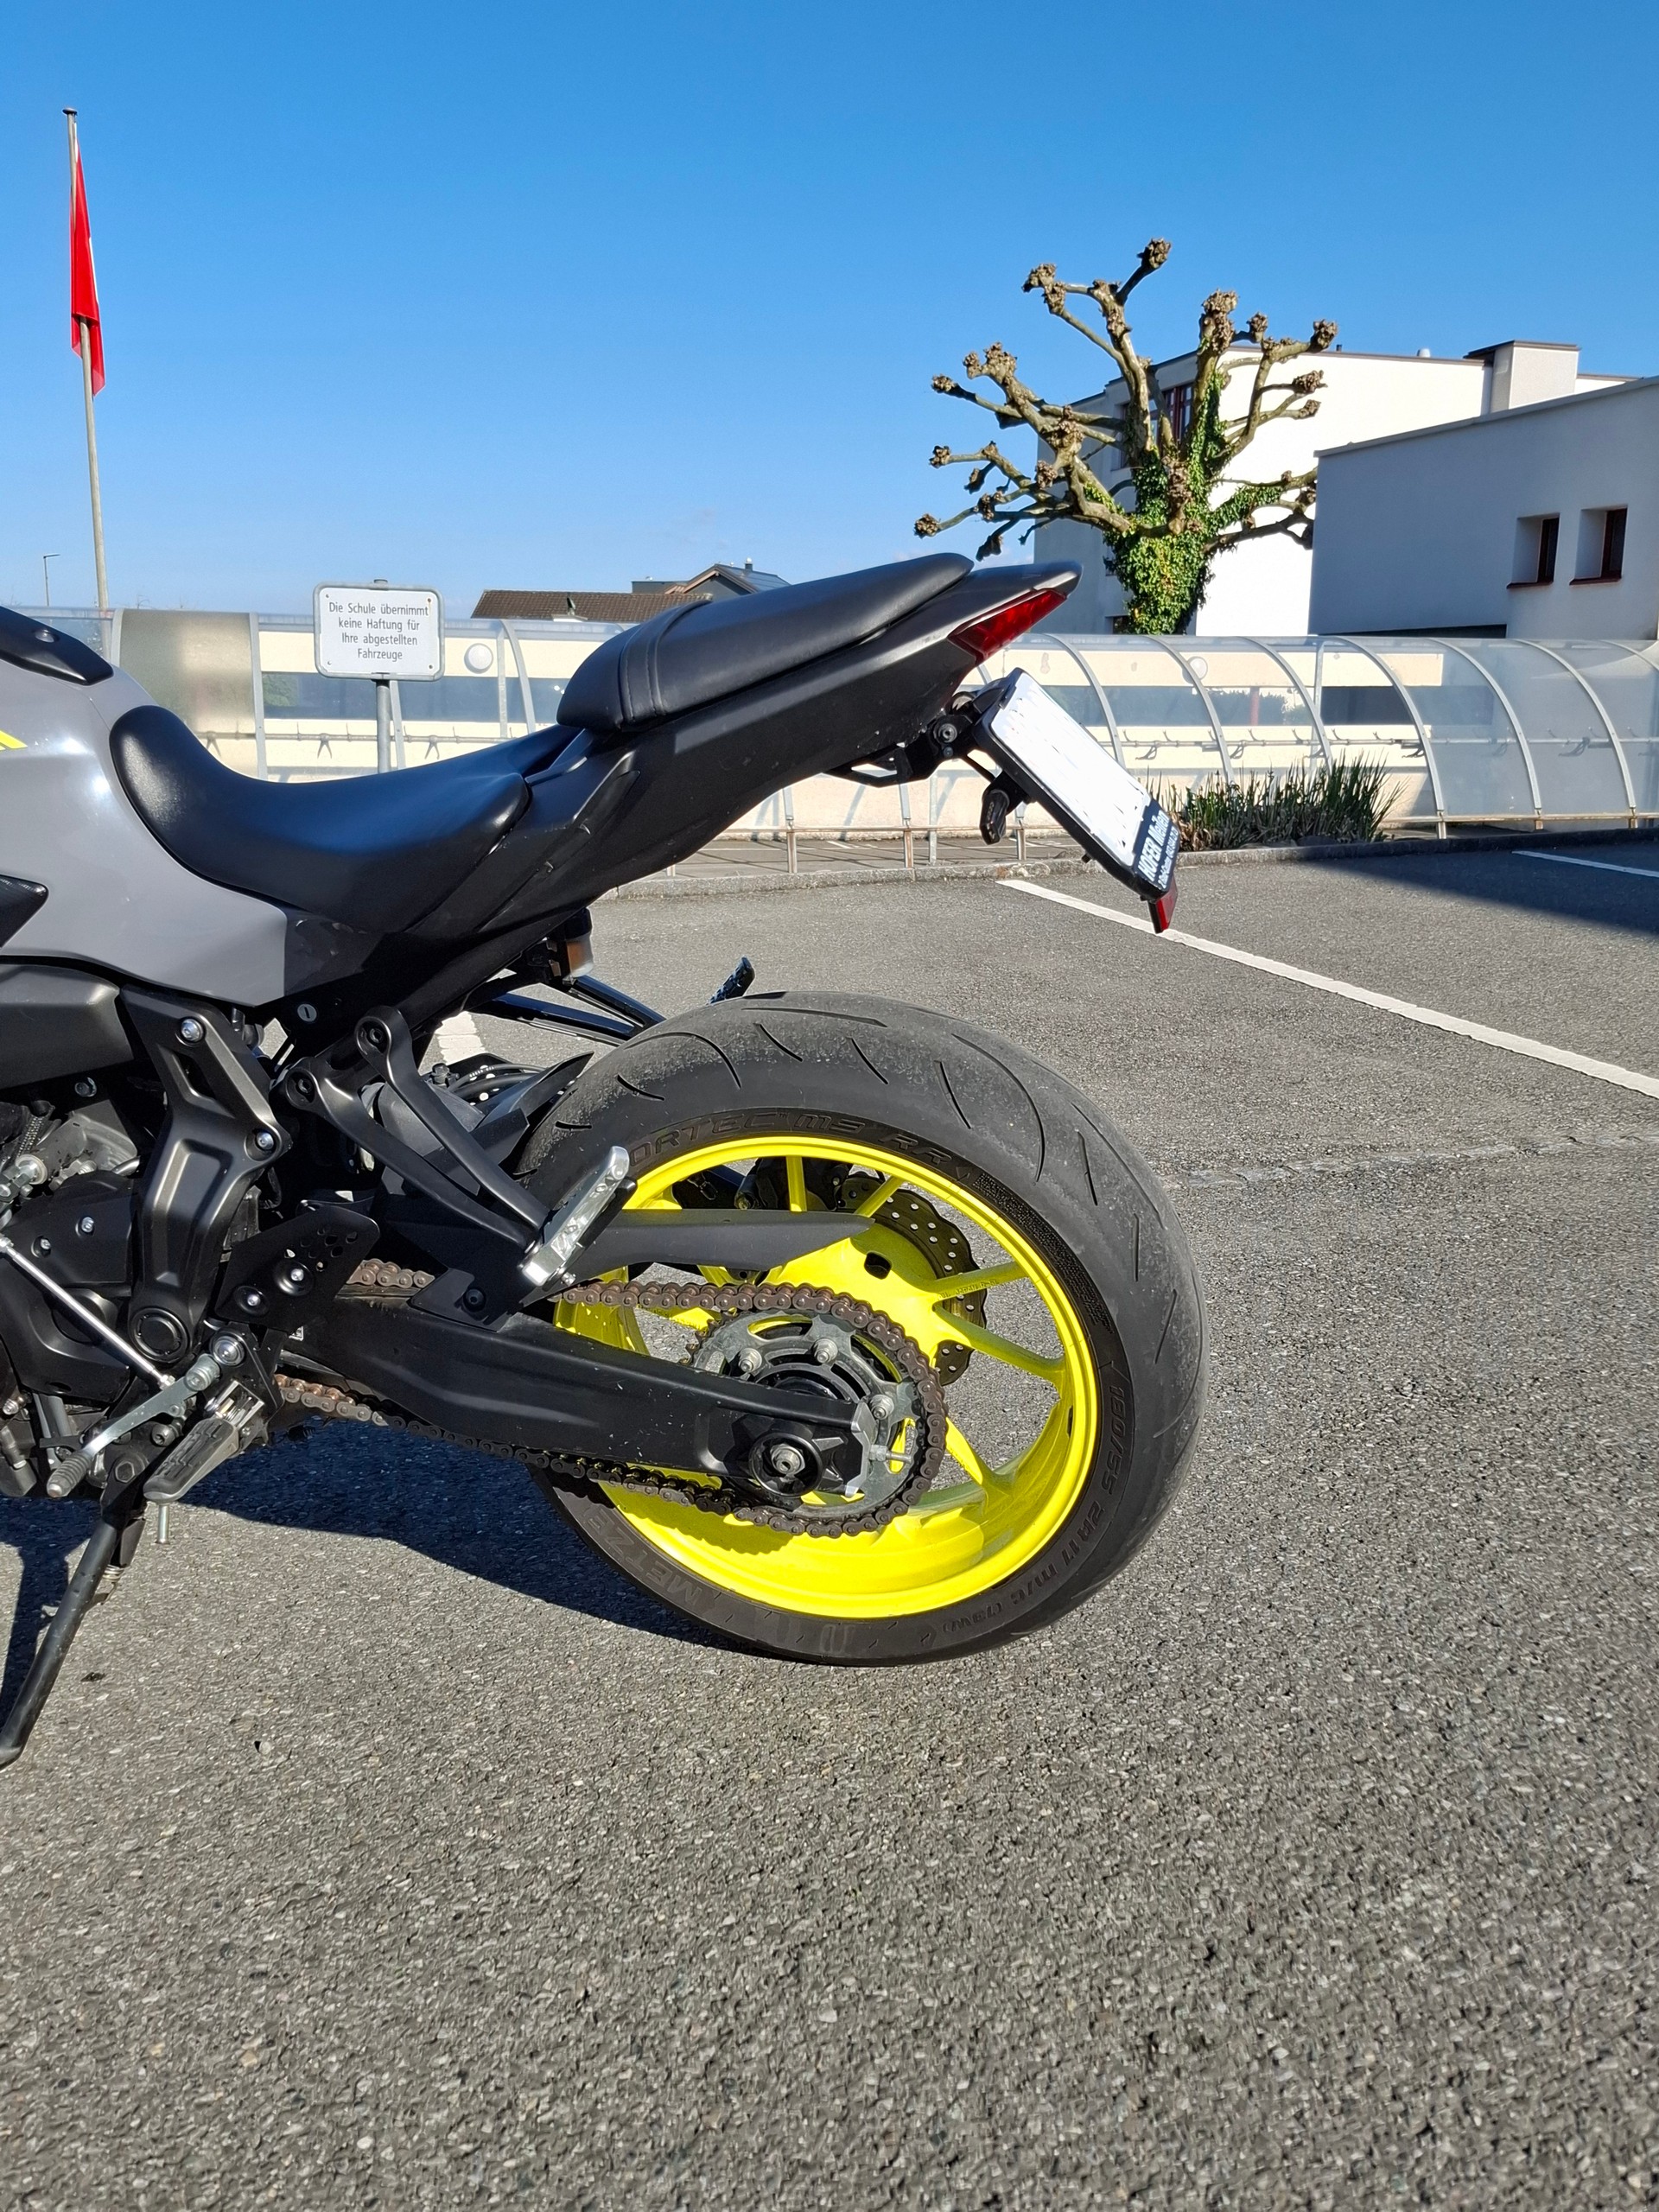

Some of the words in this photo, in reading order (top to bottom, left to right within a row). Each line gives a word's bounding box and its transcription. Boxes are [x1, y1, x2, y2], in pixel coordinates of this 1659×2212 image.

[328, 601, 343, 613] Die
[347, 602, 376, 614] Schule
[380, 604, 429, 616] übernimmt
[338, 617, 362, 628] keine
[366, 618, 402, 632] Haftung
[407, 620, 420, 631] für
[341, 632, 358, 643] Ihre
[363, 633, 417, 646] abgestellten
[357, 648, 403, 662] Fahrzeuge
[1147, 810, 1170, 847] Meilen
[1138, 836, 1162, 882] HOFER
[878, 1133, 951, 1165] RR
[1102, 1386, 1126, 1495] 180/55
[584, 1508, 703, 1606] METZE
[1010, 1563, 1058, 1605] M/C
